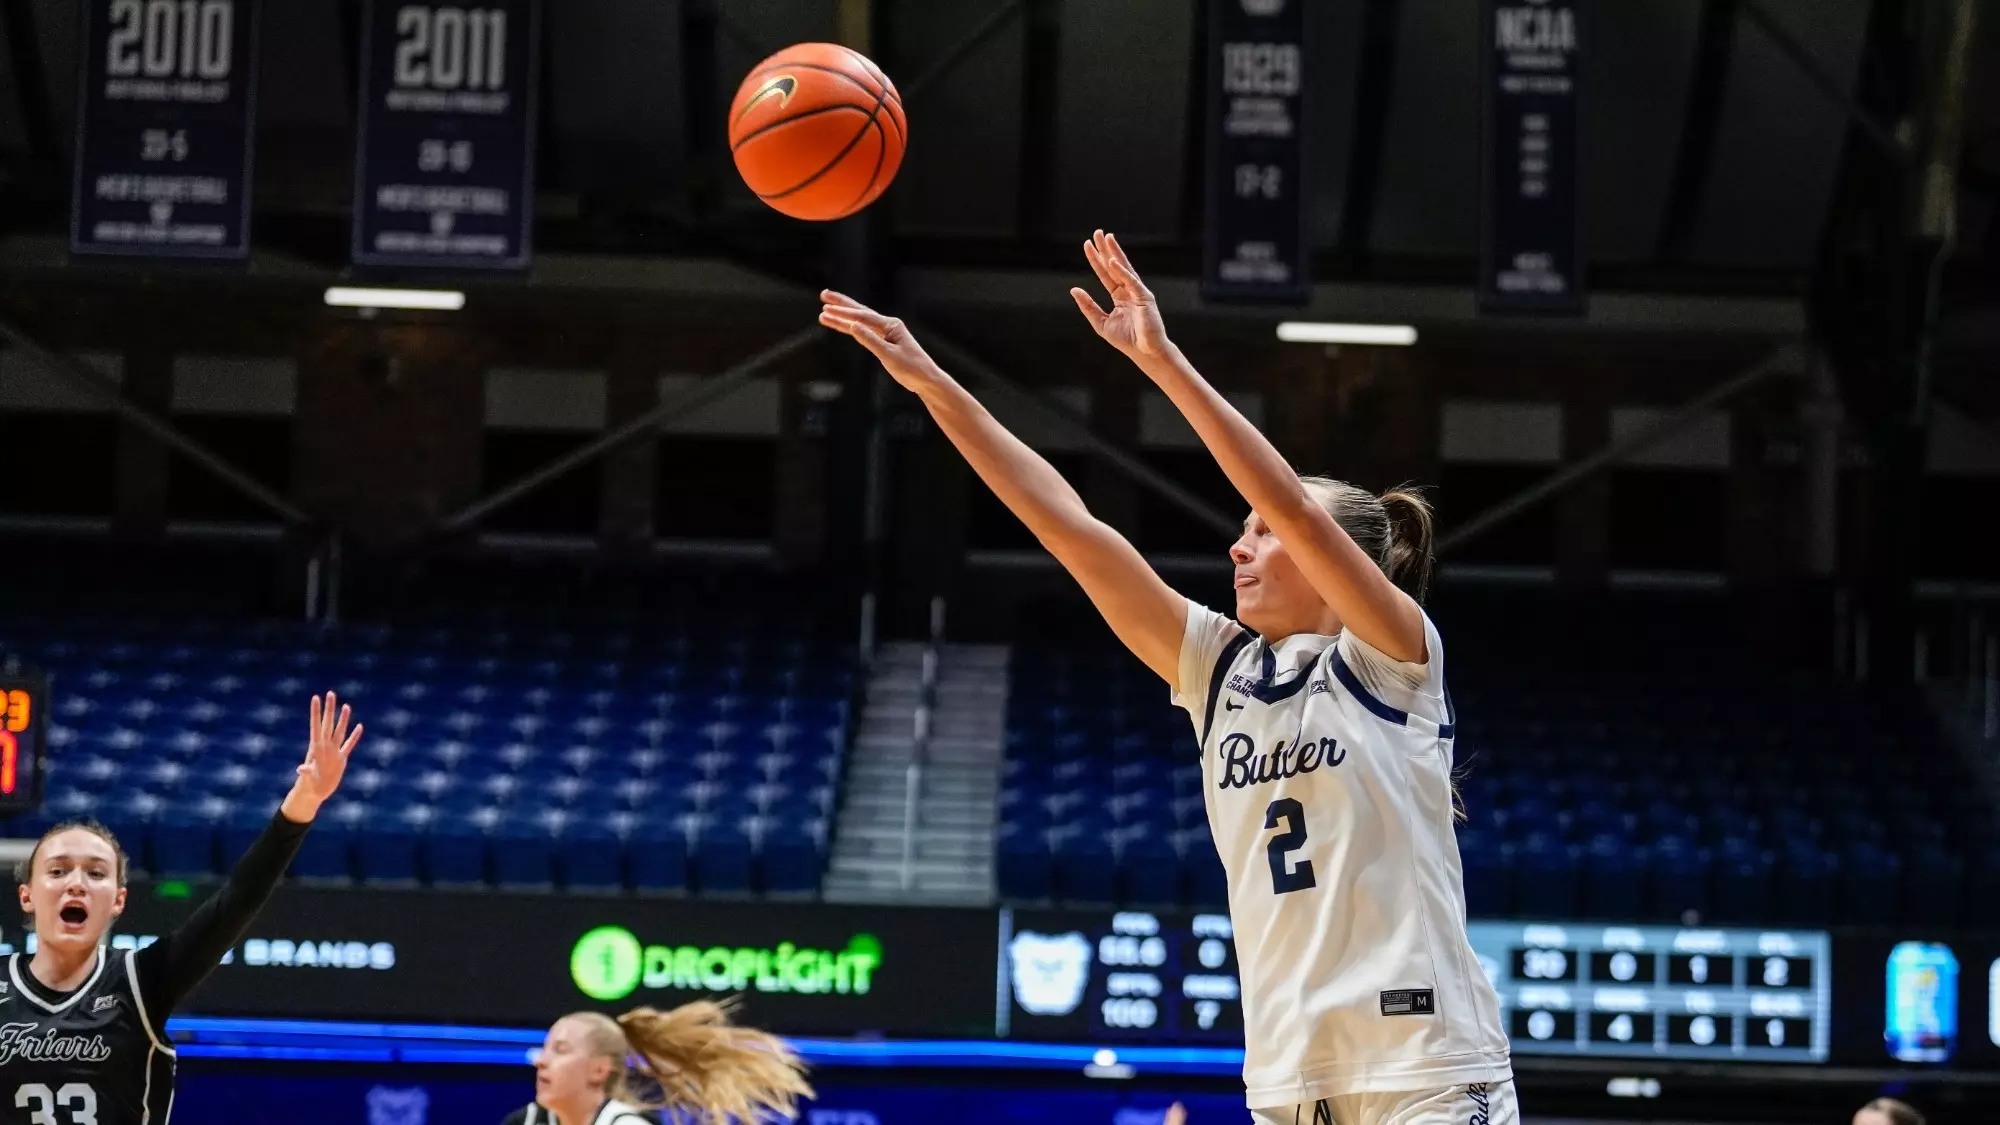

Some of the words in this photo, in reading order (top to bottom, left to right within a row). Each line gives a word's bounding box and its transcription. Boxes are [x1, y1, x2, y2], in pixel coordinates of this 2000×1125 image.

[106, 0, 234, 78] 2010
[394, 5, 507, 90] 2011
[1226, 681, 1251, 698] CHANG
[1232, 674, 1244, 684] BE
[1244, 680, 1256, 691] TH
[1264, 798, 1316, 895] 2
[1417, 995, 1426, 1007] M
[0, 1022, 111, 1062] Friars
[15, 1083, 98, 1125] 33
